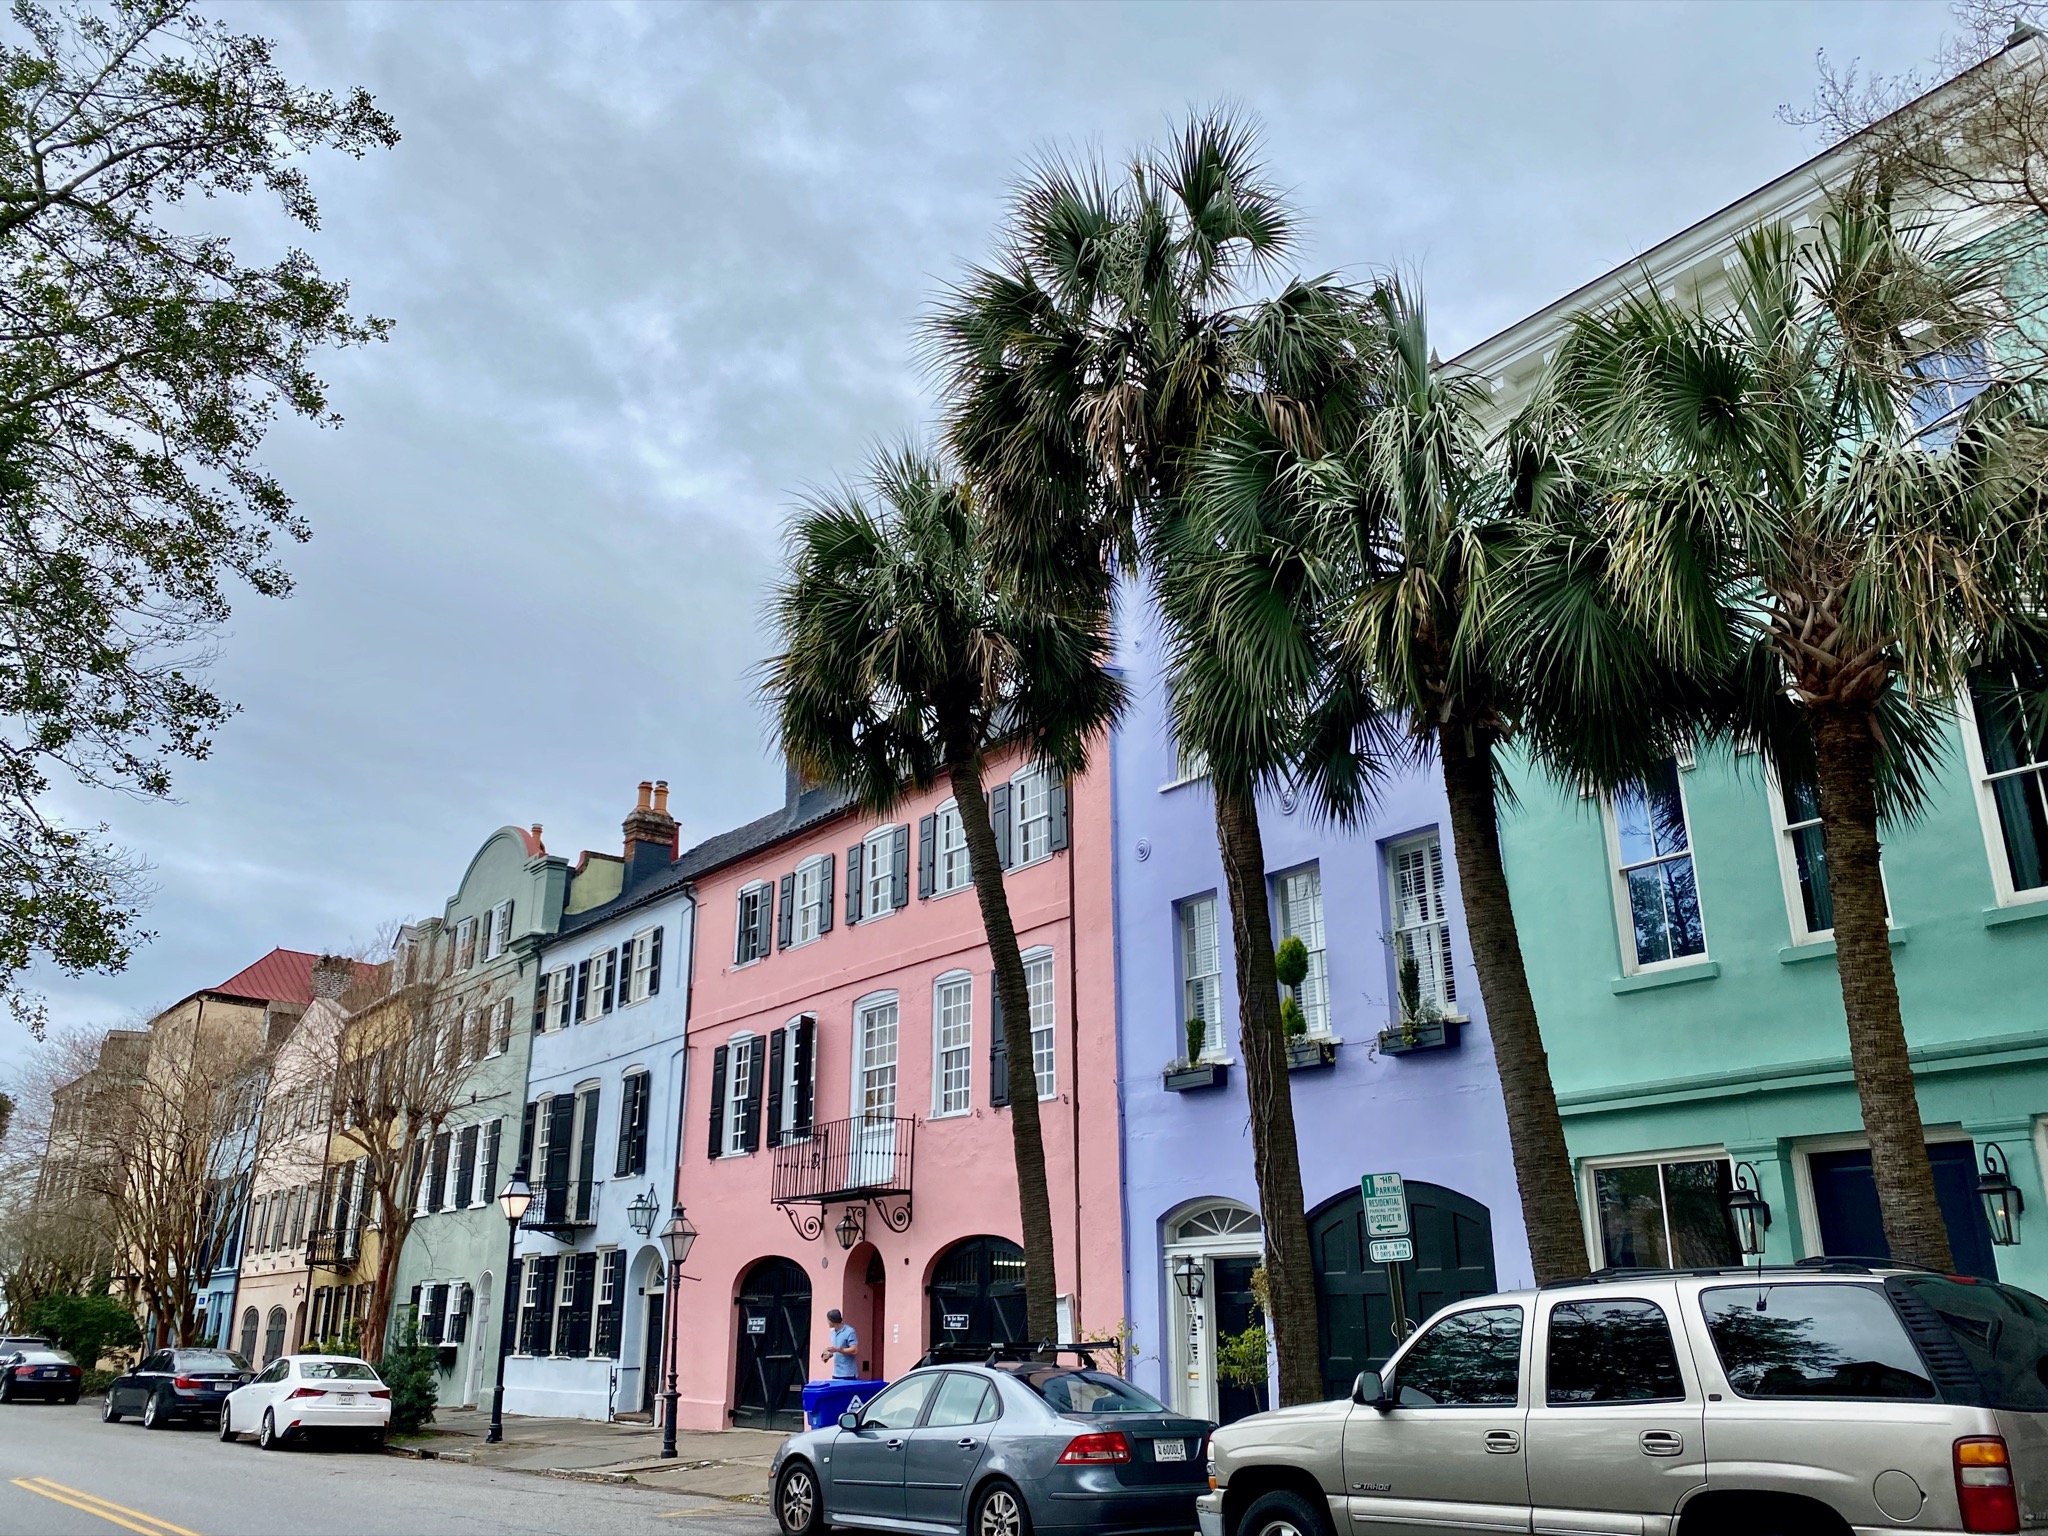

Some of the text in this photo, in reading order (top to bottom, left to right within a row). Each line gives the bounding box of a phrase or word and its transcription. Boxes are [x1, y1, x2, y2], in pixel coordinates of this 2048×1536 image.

[1366, 1175, 1393, 1194] 1 HR
[1376, 1186, 1400, 1195] PARKING
[1369, 1198, 1400, 1207] RESIDENTIAL
[1370, 1213, 1395, 1223] DISTRICT
[1380, 1250, 1391, 1258] DAYS
[1362, 1483, 1390, 1491] TAHOE
